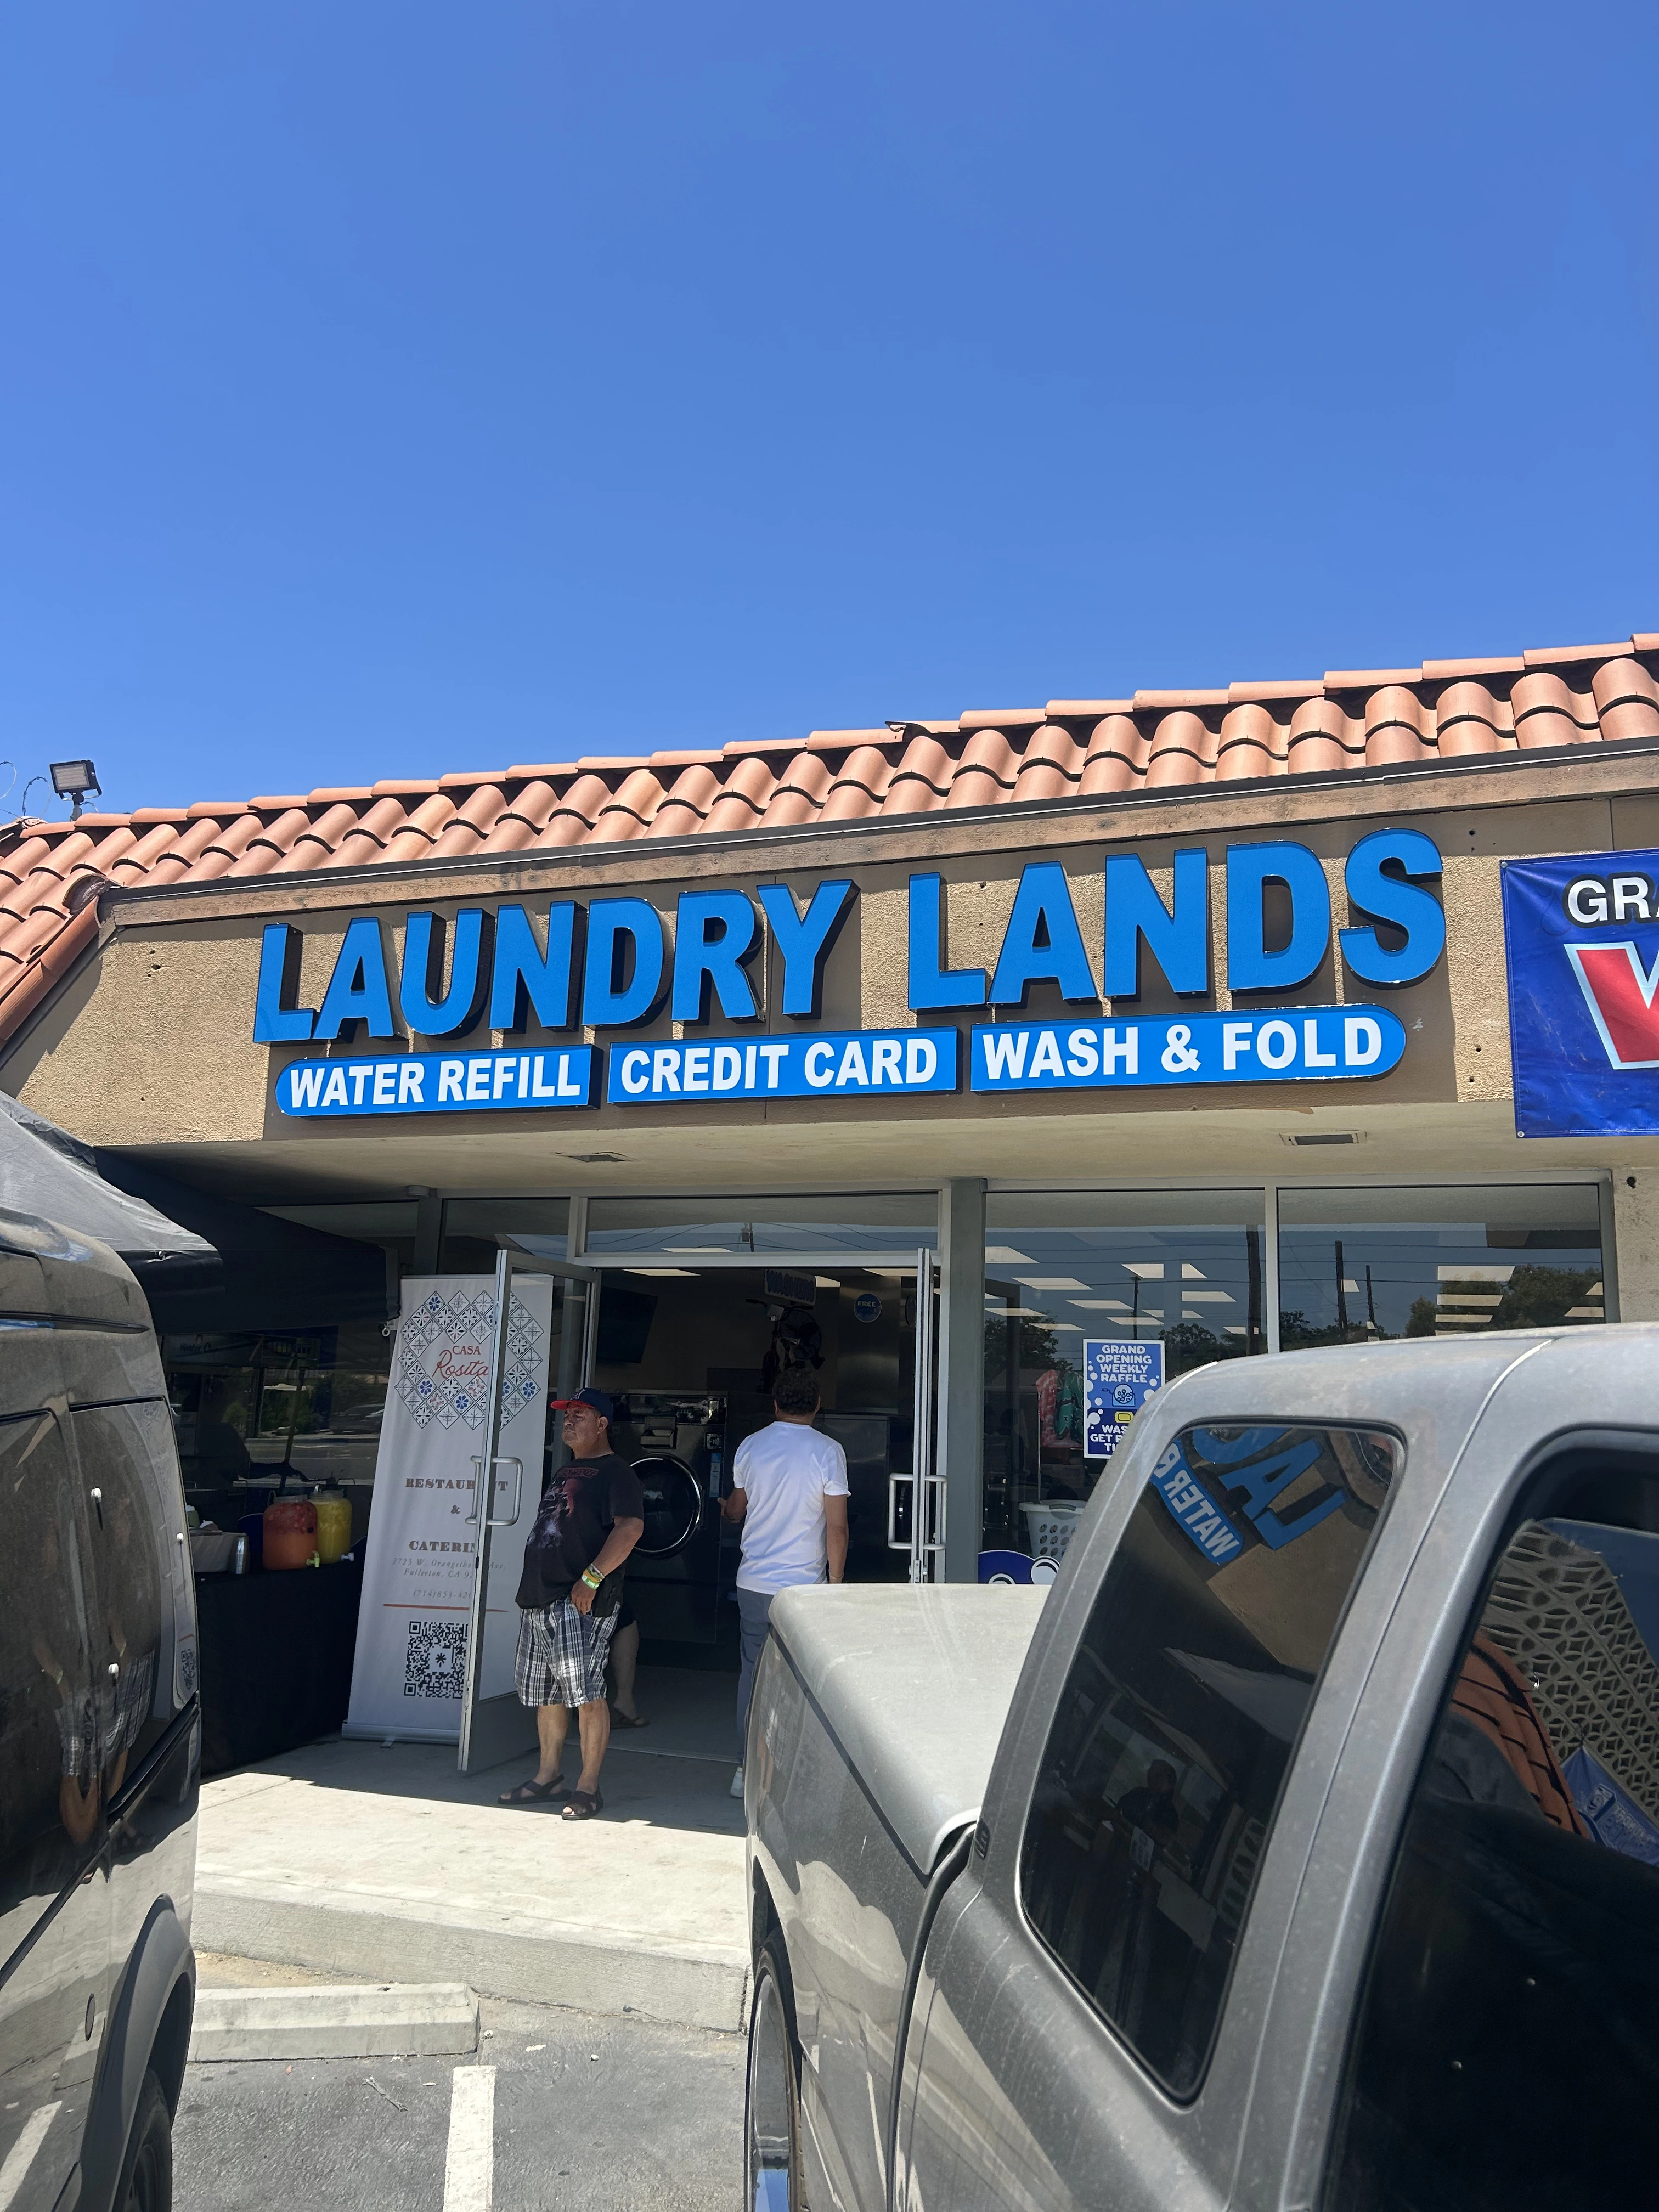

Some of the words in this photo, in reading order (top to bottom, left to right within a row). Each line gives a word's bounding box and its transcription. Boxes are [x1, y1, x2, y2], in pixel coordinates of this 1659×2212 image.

[1568, 877, 1659, 923] GR
[252, 879, 856, 1043] LAUNDRY
[908, 828, 1447, 1011] LANDS
[983, 1025, 1138, 1081] WASH
[1161, 1023, 1201, 1073] &
[1222, 1017, 1383, 1070] FOLD
[620, 1043, 788, 1094] CREDIT
[803, 1037, 938, 1088] CARD
[290, 1060, 425, 1109] WATER
[438, 1052, 582, 1103] REFILL
[453, 1346, 481, 1355] CASA
[1102, 1345, 1146, 1354] GRAND
[1096, 1354, 1152, 1364] OPENING
[432, 1350, 489, 1379] Rosita
[1099, 1364, 1148, 1373] WEEKLY
[1101, 1373, 1148, 1383] RAFFLE
[1090, 1433, 1113, 1442] GET
[405, 1478, 508, 1491] RESTAURT
[451, 1504, 461, 1514] &
[431, 1559, 471, 1568] Orangetho
